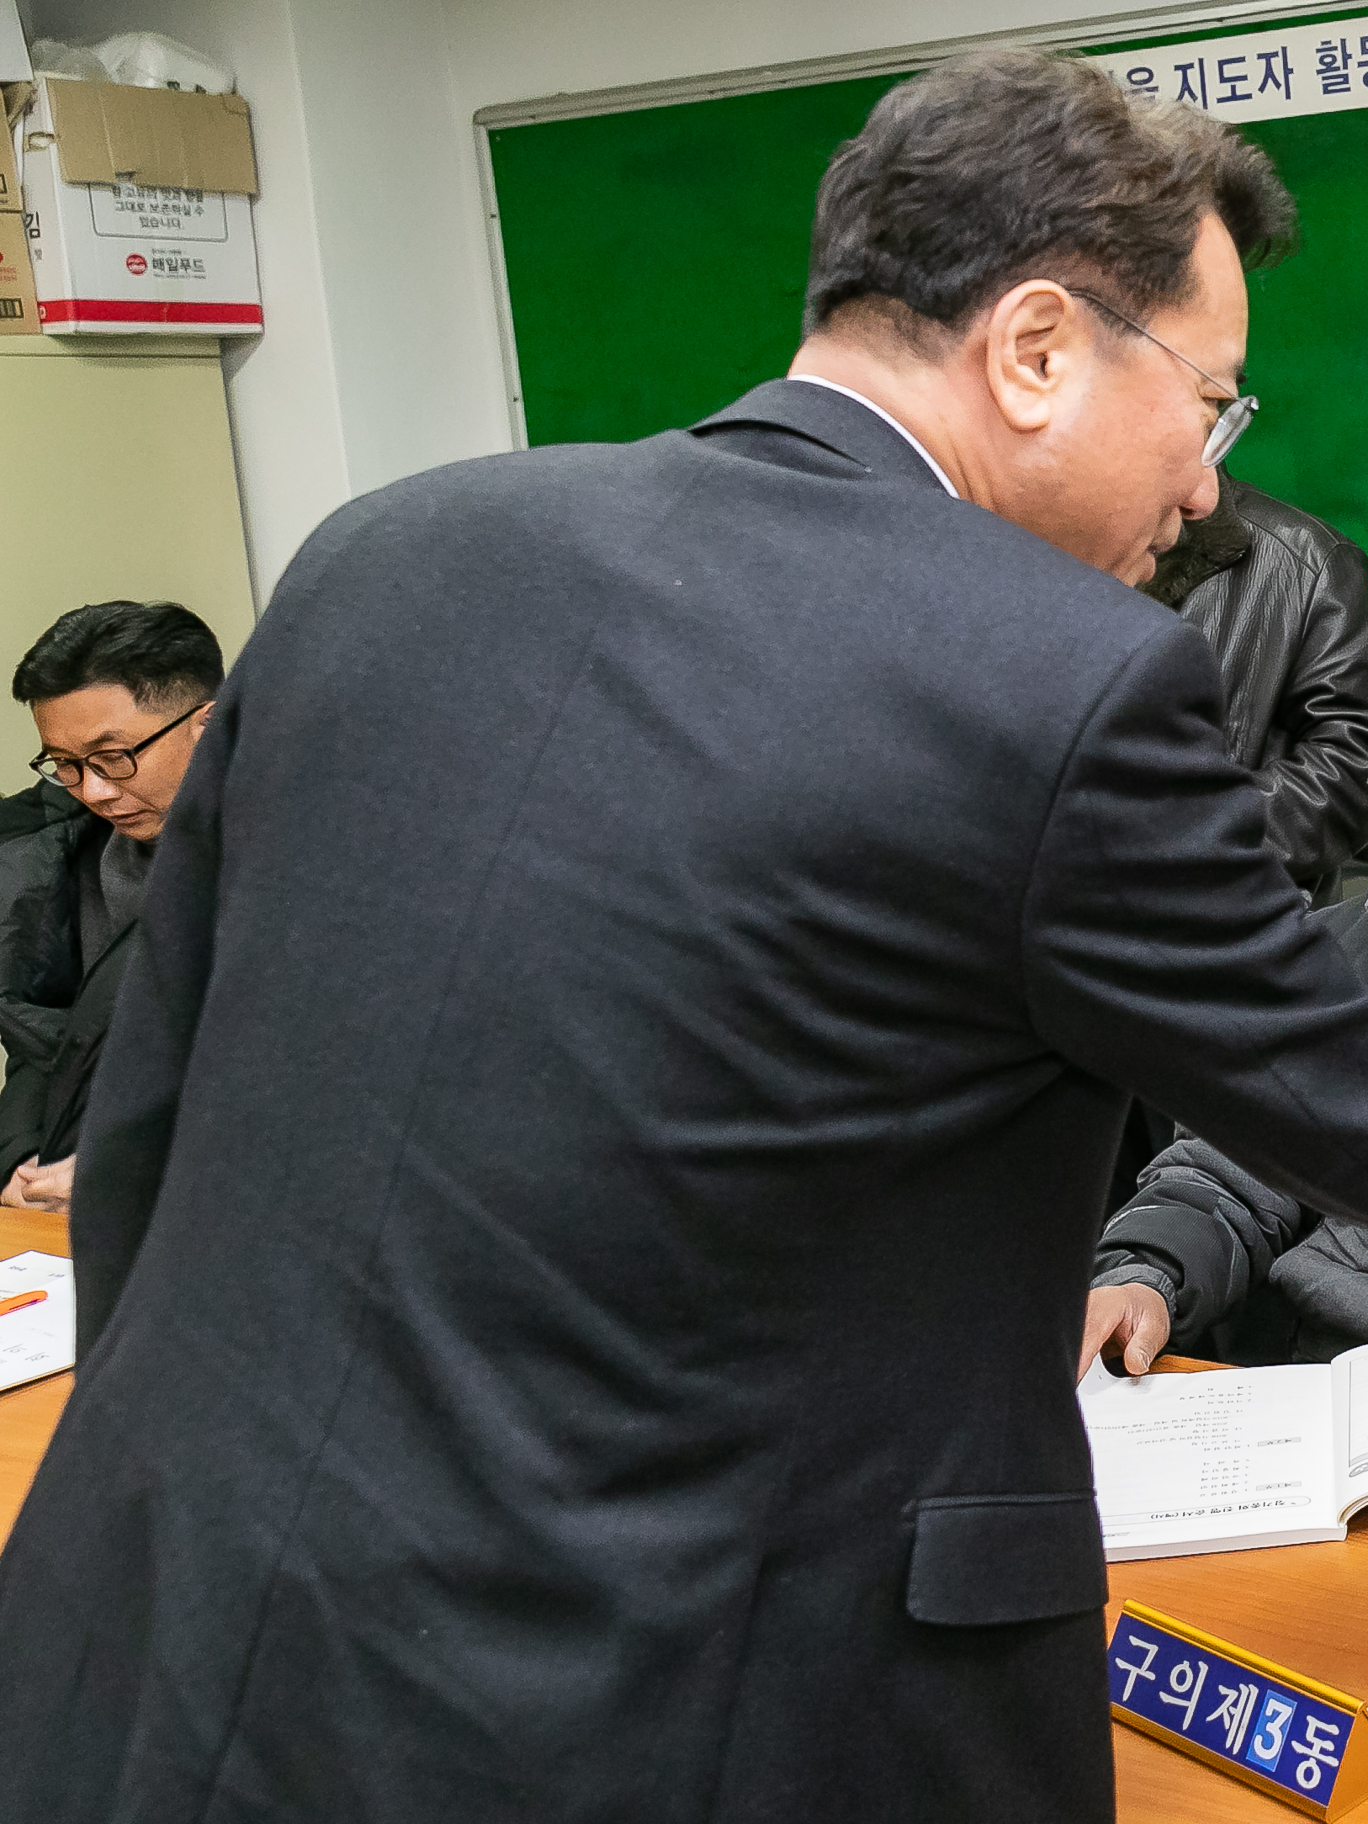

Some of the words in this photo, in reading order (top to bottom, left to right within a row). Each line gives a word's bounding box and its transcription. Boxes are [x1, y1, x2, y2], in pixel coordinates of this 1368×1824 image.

[1174, 46, 1295, 110] 지도자
[152, 257, 206, 273] 매일푸드
[1115, 1634, 1340, 1790] 구의제3동
